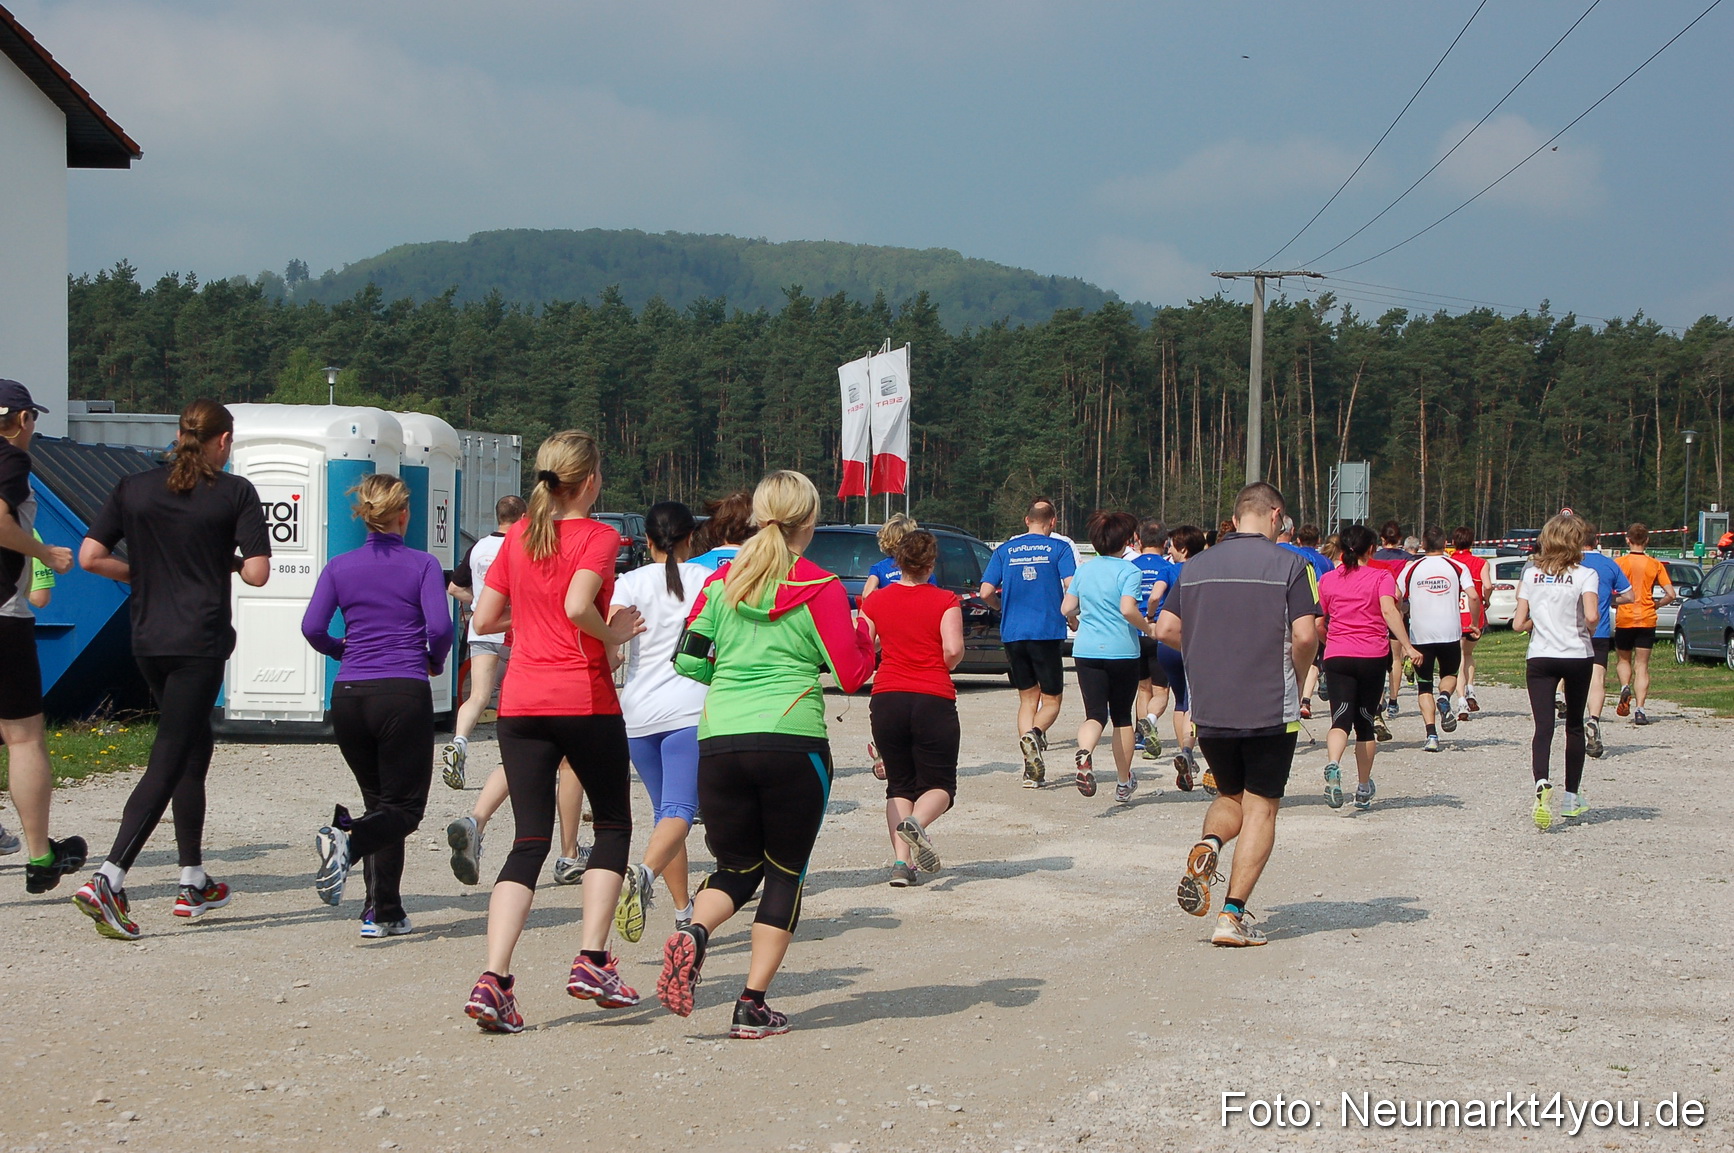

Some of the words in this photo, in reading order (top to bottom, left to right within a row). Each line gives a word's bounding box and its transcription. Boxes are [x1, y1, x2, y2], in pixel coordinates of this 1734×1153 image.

[261, 502, 298, 522] TOI
[436, 505, 448, 524] TOI
[436, 525, 447, 543] TOI
[279, 565, 296, 574] 808
[299, 565, 310, 574] 30
[252, 667, 296, 683] HMT
